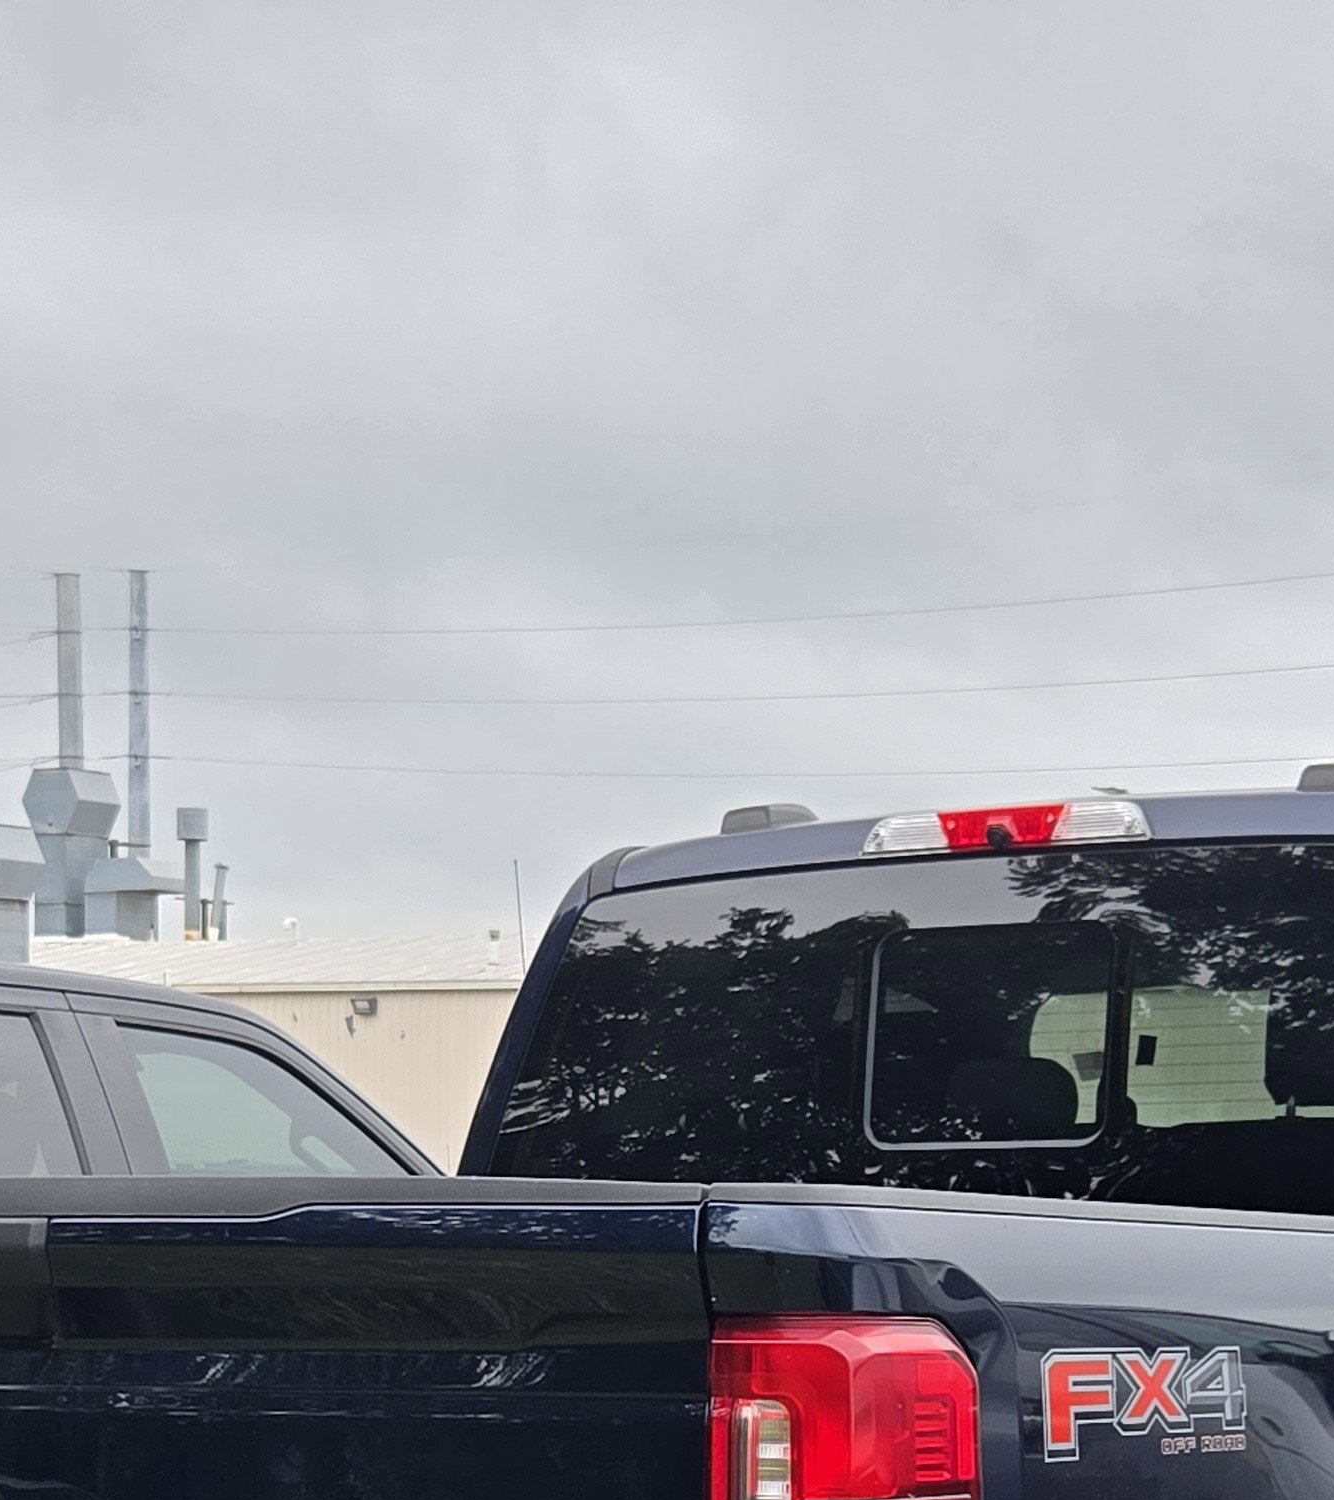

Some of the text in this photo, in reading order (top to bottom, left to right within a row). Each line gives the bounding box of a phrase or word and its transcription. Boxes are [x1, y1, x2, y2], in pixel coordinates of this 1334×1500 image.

[1041, 1346, 1247, 1462] FX4
[1161, 1434, 1246, 1454] OFF ROAD
